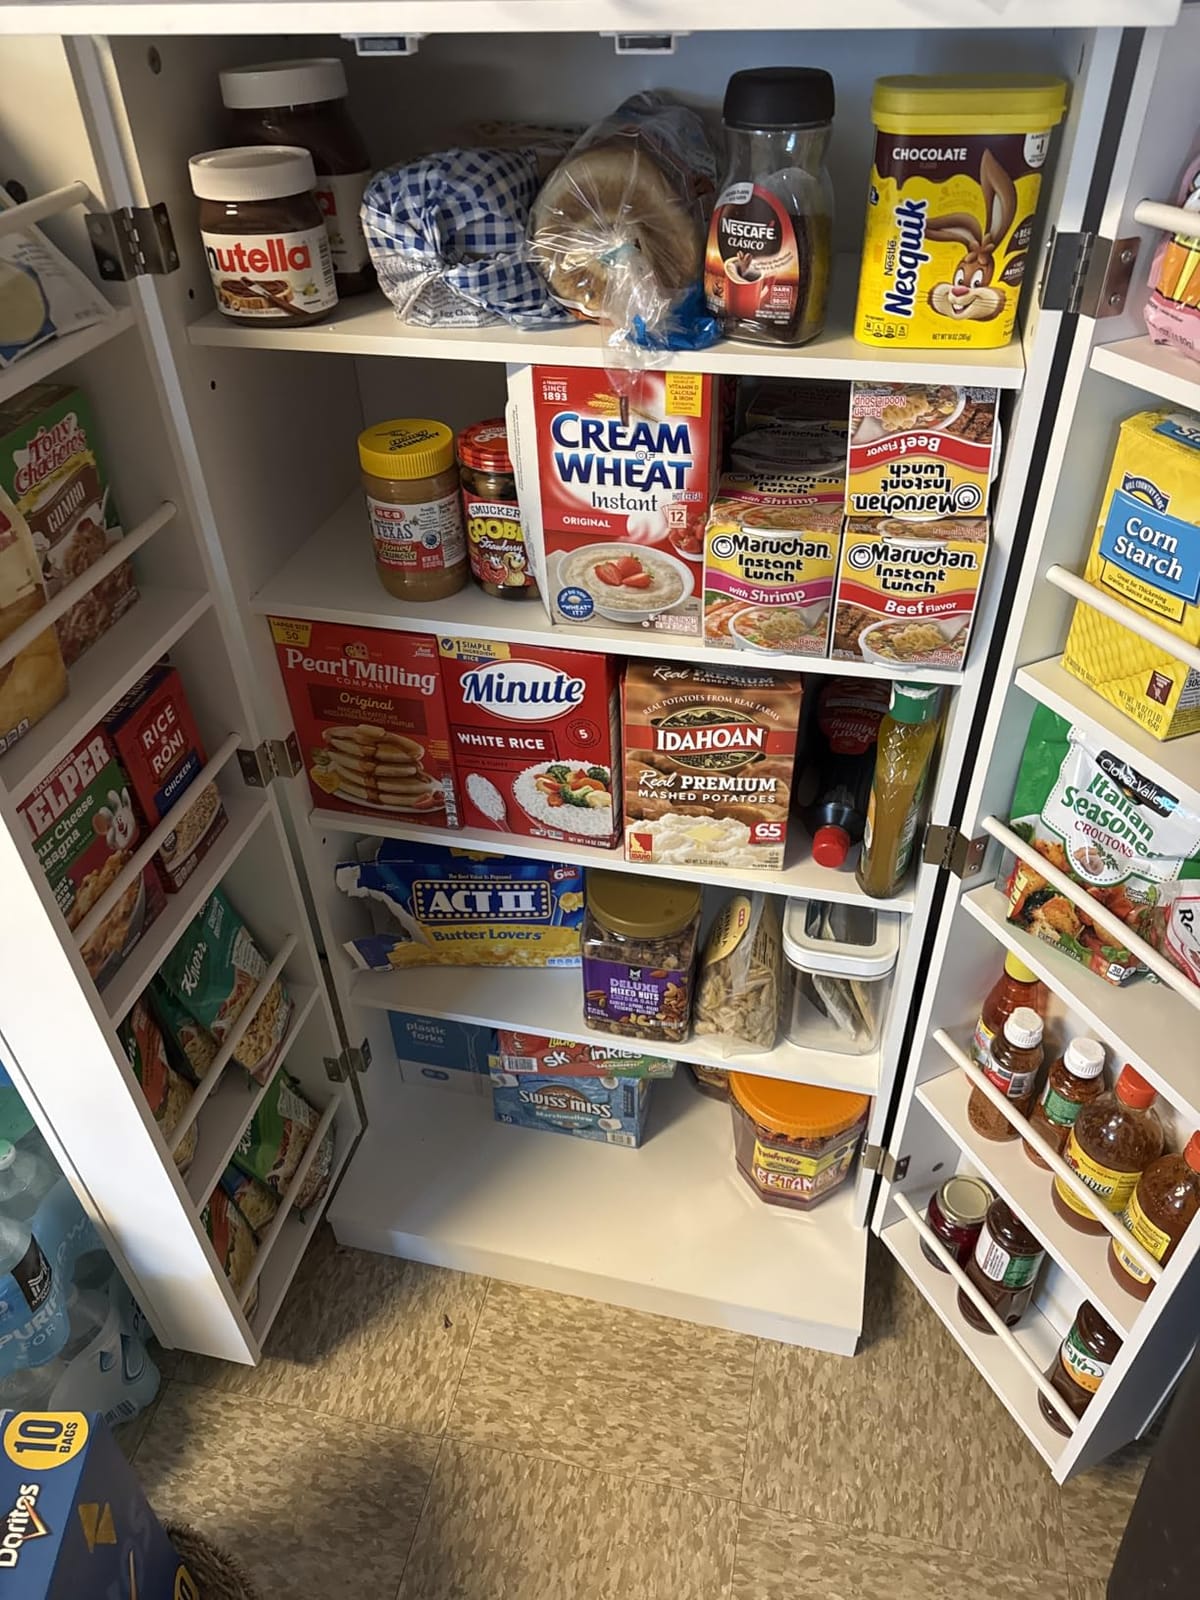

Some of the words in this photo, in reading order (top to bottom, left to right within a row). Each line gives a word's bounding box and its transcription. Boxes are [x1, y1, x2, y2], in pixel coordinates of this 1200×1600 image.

[892, 147, 967, 161] CHOCOLATE
[722, 217, 776, 243] NESCAFÉ
[727, 237, 765, 250] CLÁSICO
[206, 239, 311, 272] nutella
[884, 200, 929, 316] Nesquik
[543, 385, 567, 393] SINCE
[543, 392, 567, 401] 1893
[29, 416, 72, 462] Tony
[553, 413, 691, 454] CREAM
[866, 442, 899, 457] Flavor
[899, 436, 941, 454] Beef
[635, 451, 655, 461] OF
[555, 452, 692, 492] WHEAT
[890, 464, 944, 475] Lunch
[750, 473, 840, 484] Maruchan
[753, 481, 816, 489] Instant
[881, 478, 951, 492] Instant
[592, 492, 657, 512] Instant
[762, 497, 819, 505] Shrimp
[855, 494, 957, 516] Maruchan
[563, 516, 610, 528] ORIGINAL
[671, 512, 684, 522] 12
[376, 524, 413, 539] TEXAS
[1126, 517, 1178, 553] Corn
[733, 535, 829, 558] Maruchan
[739, 554, 803, 570] Instant
[872, 544, 975, 568] Maruchan
[1114, 535, 1183, 581] Starch
[744, 568, 795, 582] Lunch
[876, 565, 946, 581] Instant
[882, 578, 935, 593] Lunch
[1126, 585, 1142, 598] Sauces
[1138, 583, 1167, 604] Thickening
[729, 586, 748, 598] with
[750, 589, 805, 603] Shrimp
[884, 600, 924, 614] Beef
[925, 602, 957, 613] Flavor
[286, 631, 299, 640] 50
[456, 641, 461, 652] 1
[462, 641, 492, 651] SIMPLE
[285, 648, 348, 676] Pearl
[346, 659, 436, 695] Milling
[653, 666, 689, 680] Real
[336, 677, 390, 690] COMPANY
[462, 672, 583, 704] Minute
[693, 677, 728, 685] MASHED
[340, 693, 394, 711] Original
[662, 694, 705, 706] POTATOES
[707, 694, 732, 704] FROM
[734, 697, 755, 710] REAL
[142, 703, 177, 750] RICE
[579, 729, 588, 739] 5
[457, 732, 505, 748] WHITE
[509, 738, 545, 750] RICE
[656, 727, 764, 751] IDAHOAN
[152, 729, 185, 774] RONI
[164, 762, 192, 797] CHICKEN
[638, 770, 675, 790] Real
[681, 775, 776, 792] PREMIUM
[1101, 758, 1137, 788] Clover
[638, 790, 696, 801] MASHED
[702, 793, 776, 804] POTATOES
[1087, 772, 1154, 842] Italian
[54, 794, 94, 841] Cheese
[755, 823, 781, 837] 65
[1074, 820, 1134, 859] CROUTONS
[553, 869, 564, 880] 6
[429, 891, 492, 912] ACT
[498, 891, 536, 911] II
[432, 930, 485, 942] Butter
[489, 929, 542, 941] Lovers
[181, 941, 208, 997] Knorr
[609, 978, 659, 993] DELUXE
[610, 987, 636, 997] MIXED
[638, 991, 660, 1001] NUTS
[406, 1022, 446, 1035] plastic
[412, 1030, 444, 1043] forks
[519, 1090, 568, 1108] SWISS
[14, 1419, 64, 1453] 10
[58, 1422, 78, 1453] BAGS
[0, 1484, 40, 1568] Doritos
